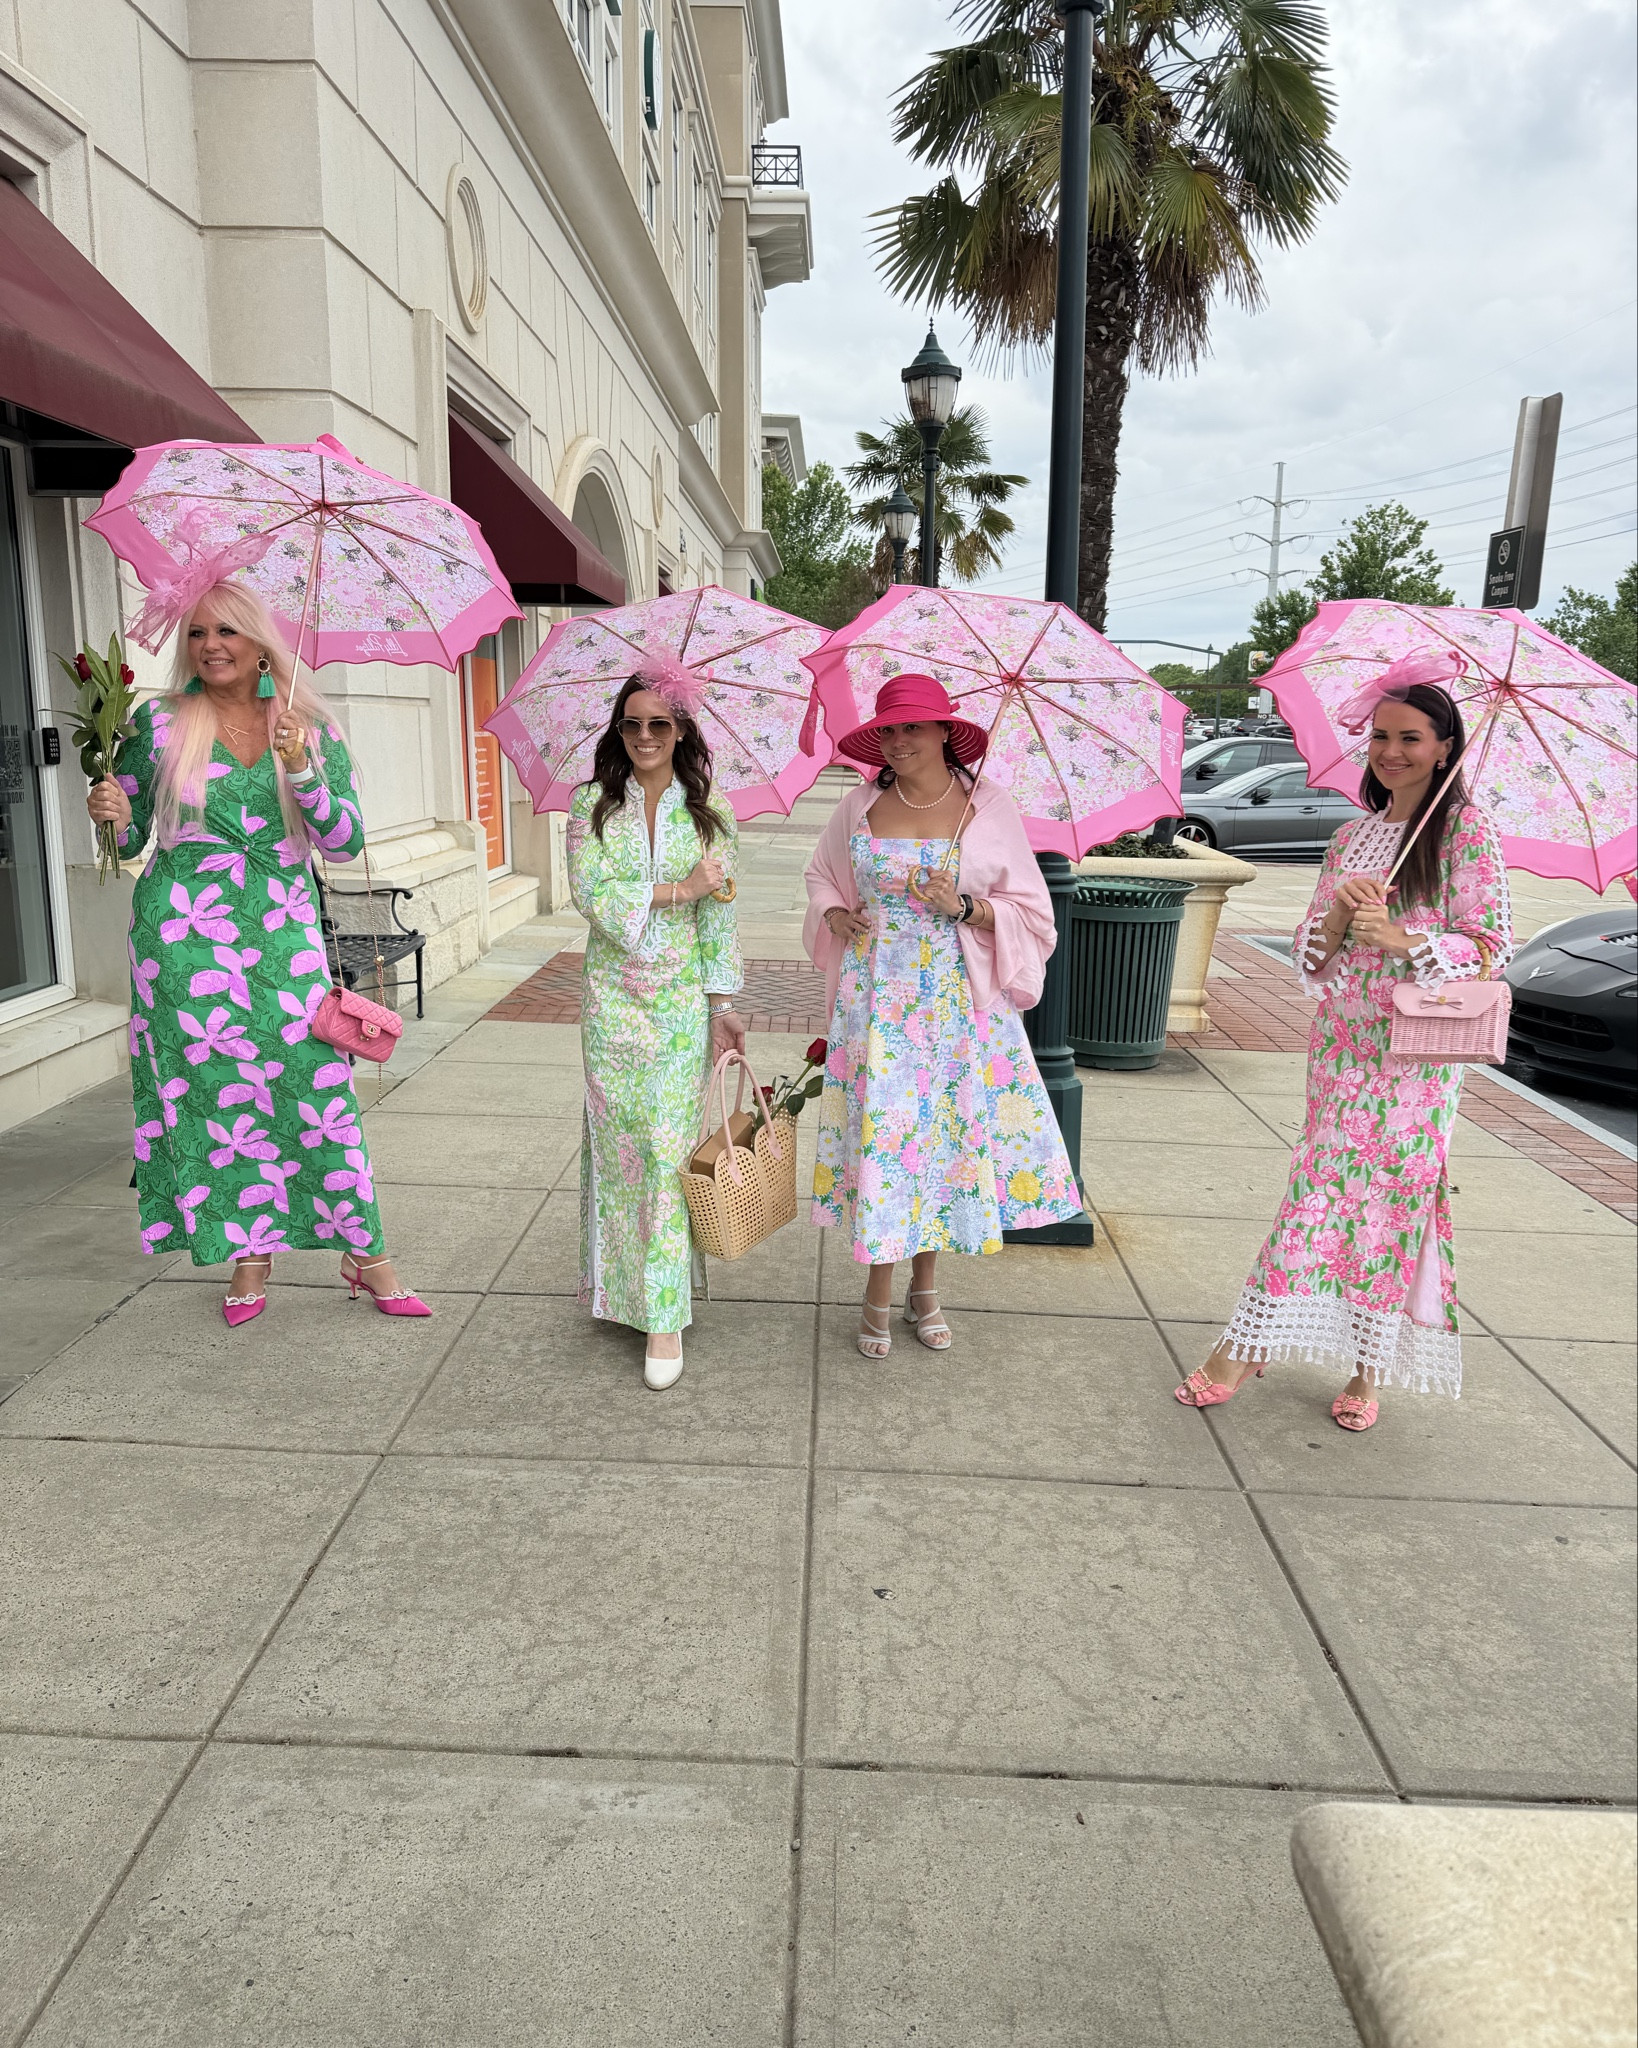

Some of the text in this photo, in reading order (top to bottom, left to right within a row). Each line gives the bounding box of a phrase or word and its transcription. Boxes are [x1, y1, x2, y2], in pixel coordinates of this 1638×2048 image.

[1489, 571, 1515, 585] Smoke Free
[1491, 586, 1509, 597] Campus
[223, 724, 249, 745] A
